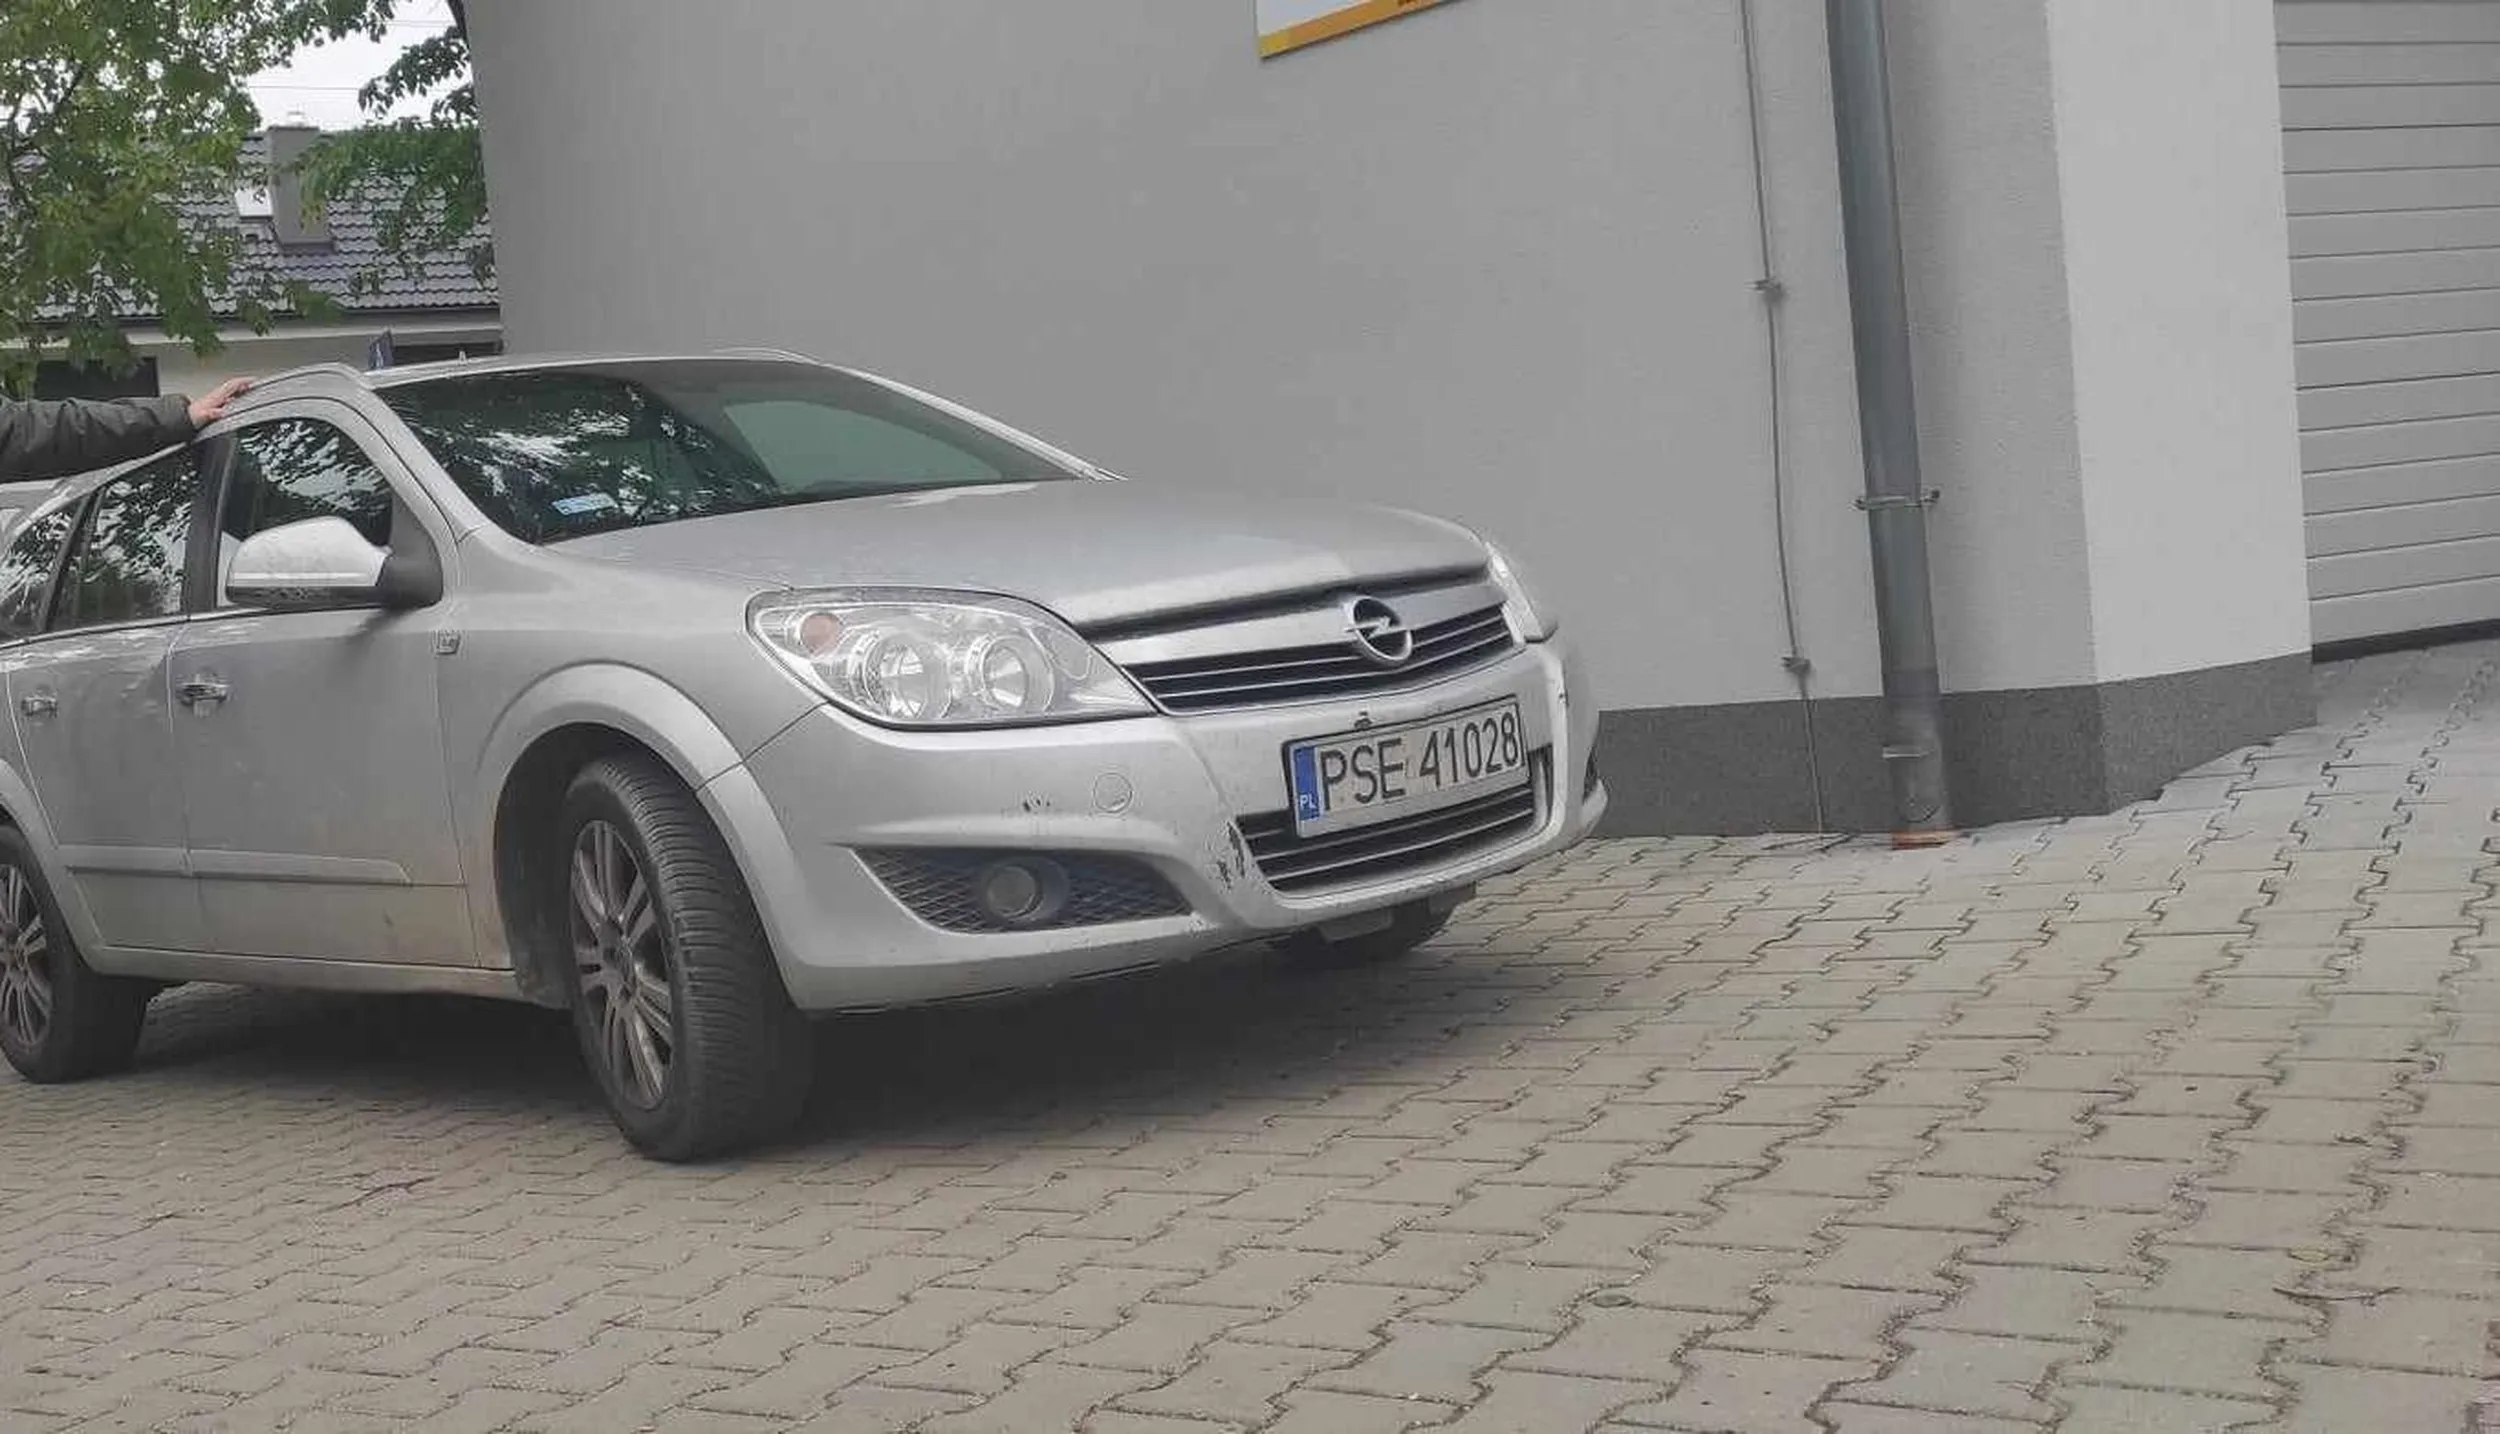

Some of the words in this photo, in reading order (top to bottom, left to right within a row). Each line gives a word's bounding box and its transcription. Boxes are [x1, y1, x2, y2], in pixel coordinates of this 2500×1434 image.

[1320, 738, 1405, 811] PSE
[1419, 711, 1519, 788] 41028
[1299, 793, 1317, 810] PL
